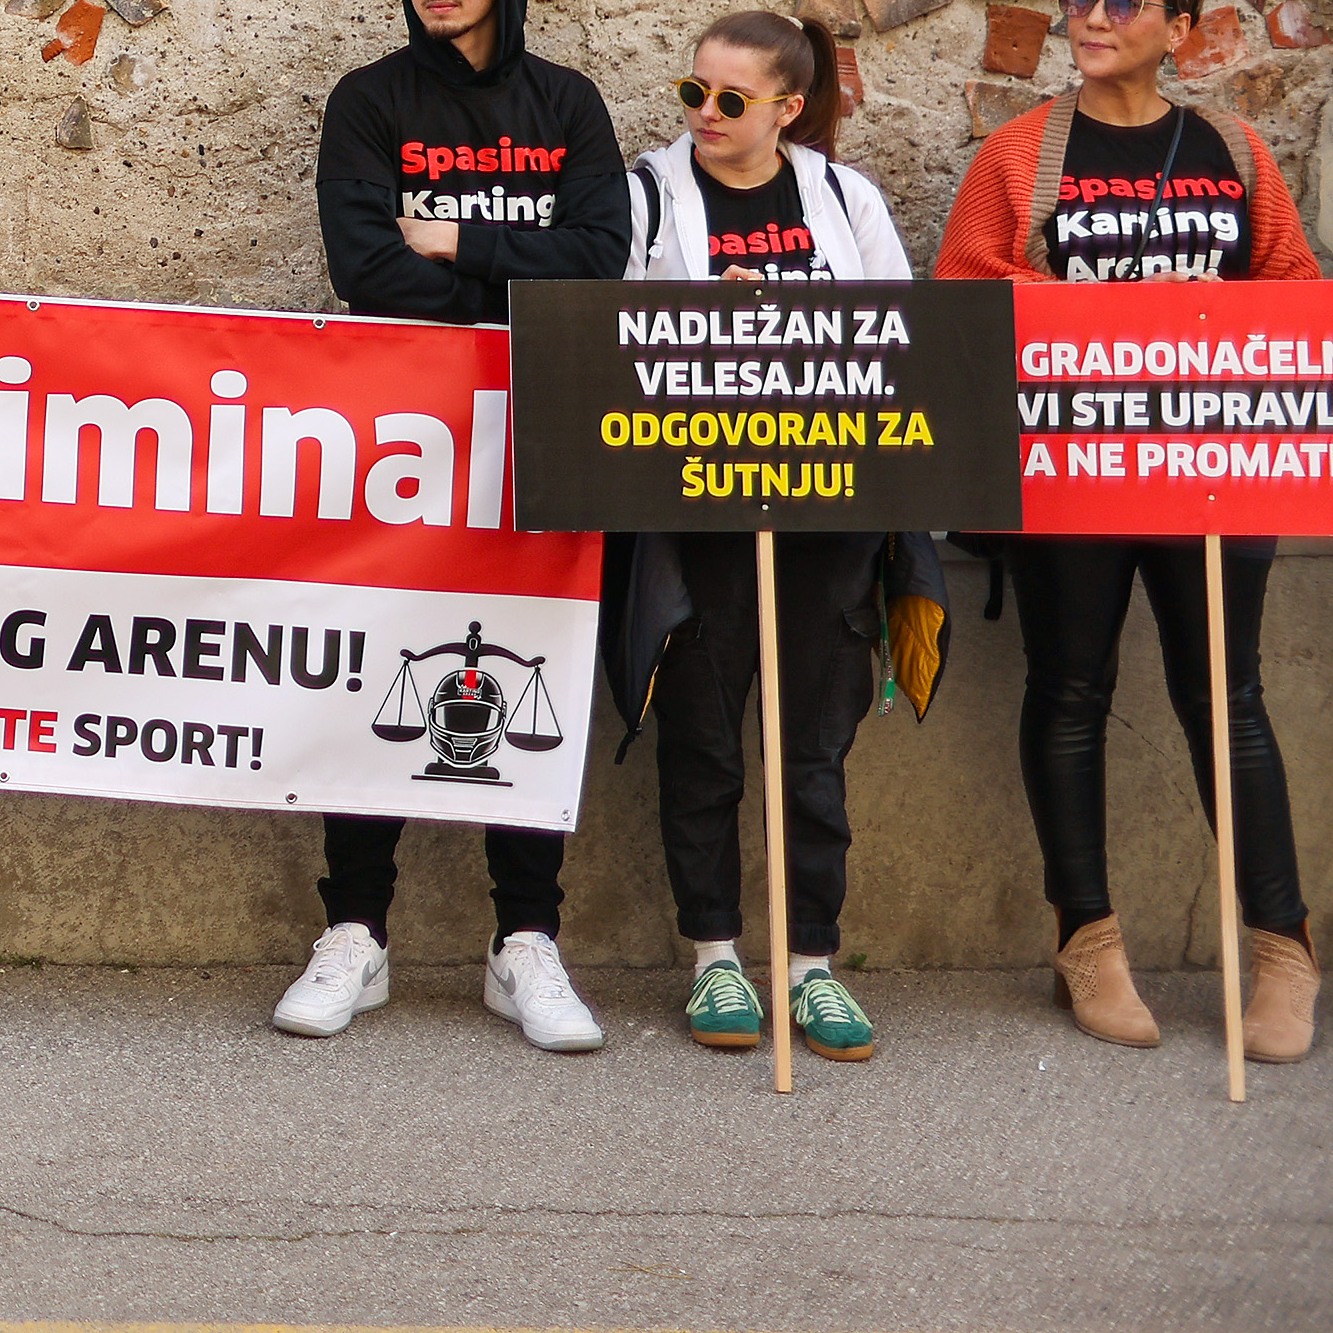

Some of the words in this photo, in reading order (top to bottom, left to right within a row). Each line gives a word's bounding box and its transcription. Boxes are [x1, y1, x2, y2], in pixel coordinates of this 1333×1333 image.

[1058, 172, 1244, 203] Spasimo
[401, 185, 556, 228] Karting
[1056, 207, 1239, 242] Karting
[618, 304, 842, 346] NADLEŽAN
[852, 310, 910, 346] ZA
[633, 360, 895, 397] VELESAJAM.
[1017, 392, 1060, 427] VI
[1071, 392, 1150, 427] STE
[600, 411, 866, 447] ODGOVORAN
[877, 411, 934, 446] ZA
[680, 456, 855, 498] ŠUTNJU!
[1024, 443, 1056, 477] A
[1069, 443, 1126, 477] NE
[1138, 442, 1333, 478] PROMAT
[67, 615, 366, 693] ARENU!
[72, 714, 263, 772] SPORT!
